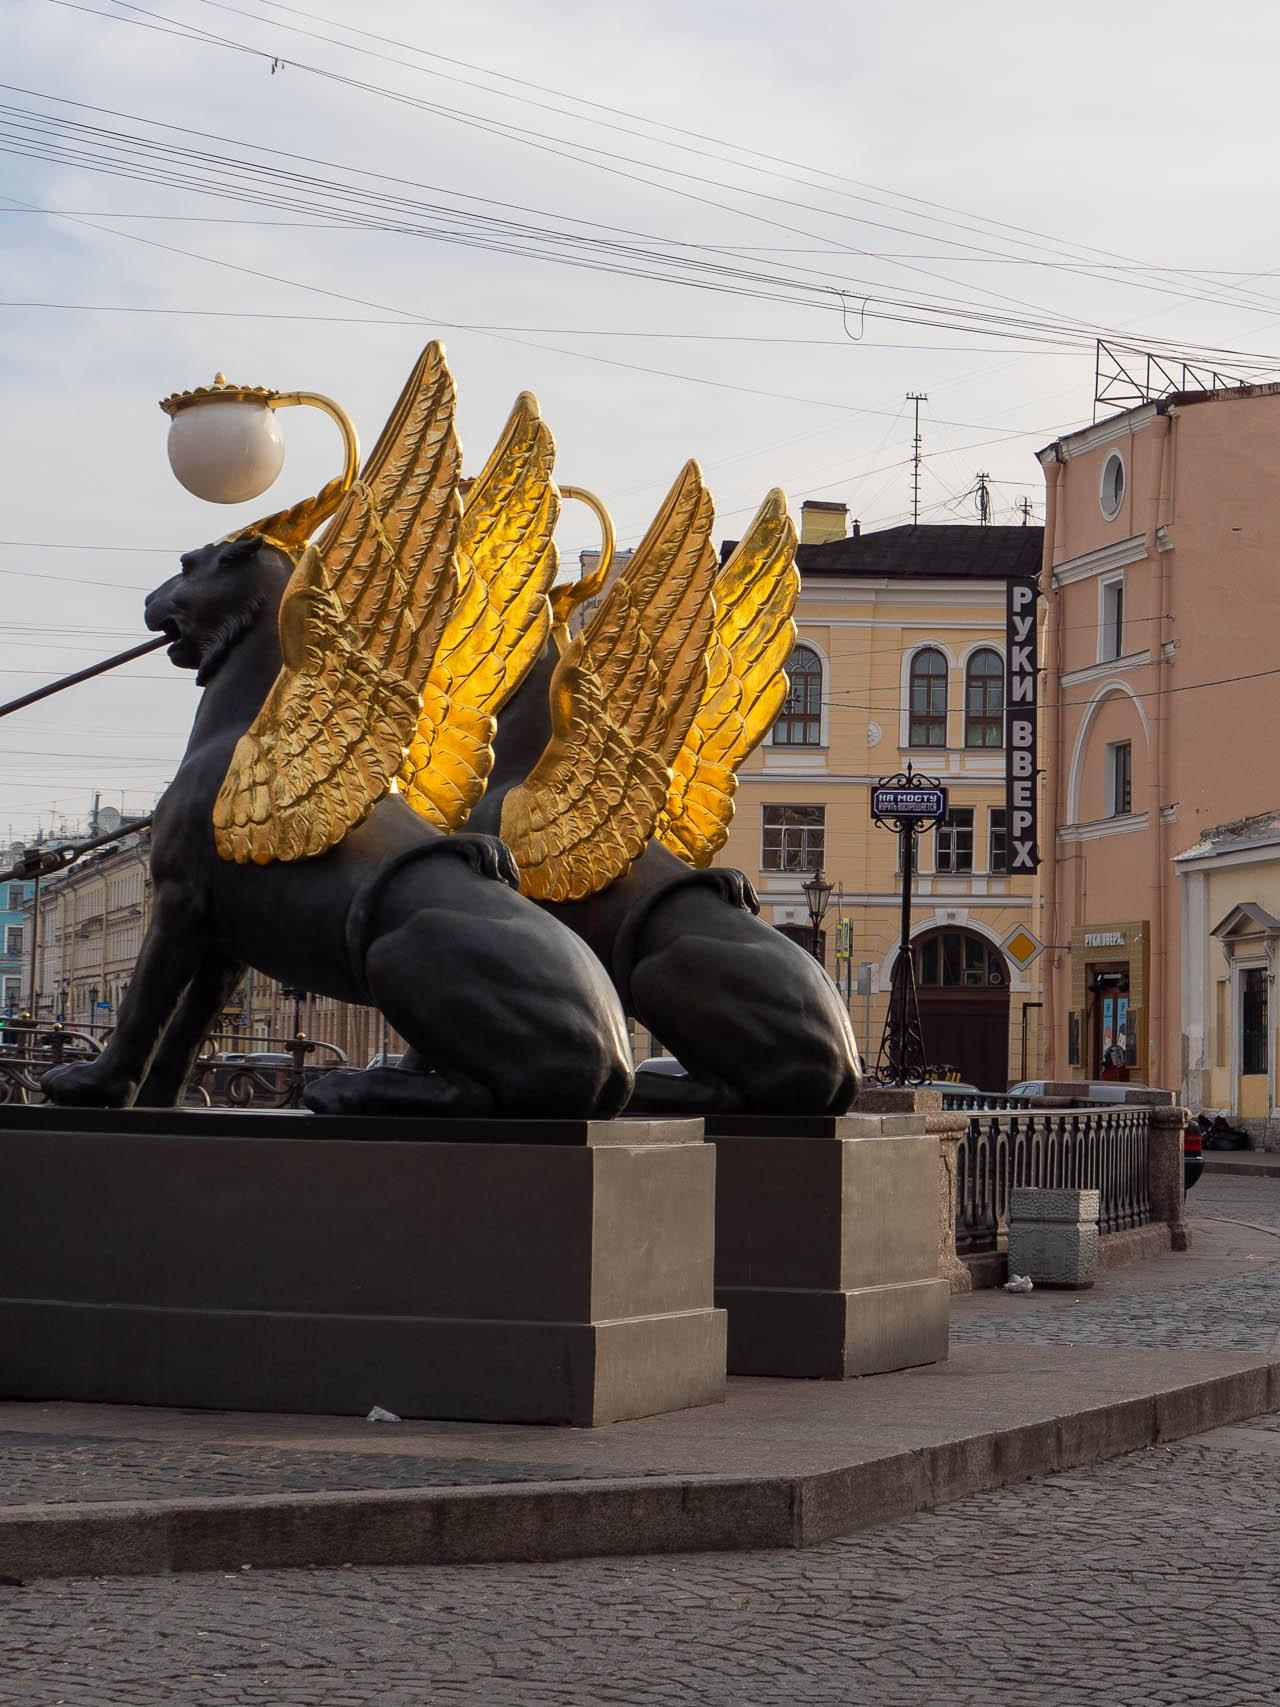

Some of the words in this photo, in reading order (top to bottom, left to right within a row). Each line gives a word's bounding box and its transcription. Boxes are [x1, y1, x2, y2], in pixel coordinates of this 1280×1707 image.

[1012, 586, 1033, 702] РУКИ
[879, 794, 894, 802] НА
[897, 794, 937, 802] МОСТУ
[1012, 721, 1034, 867] ВВЕРХ
